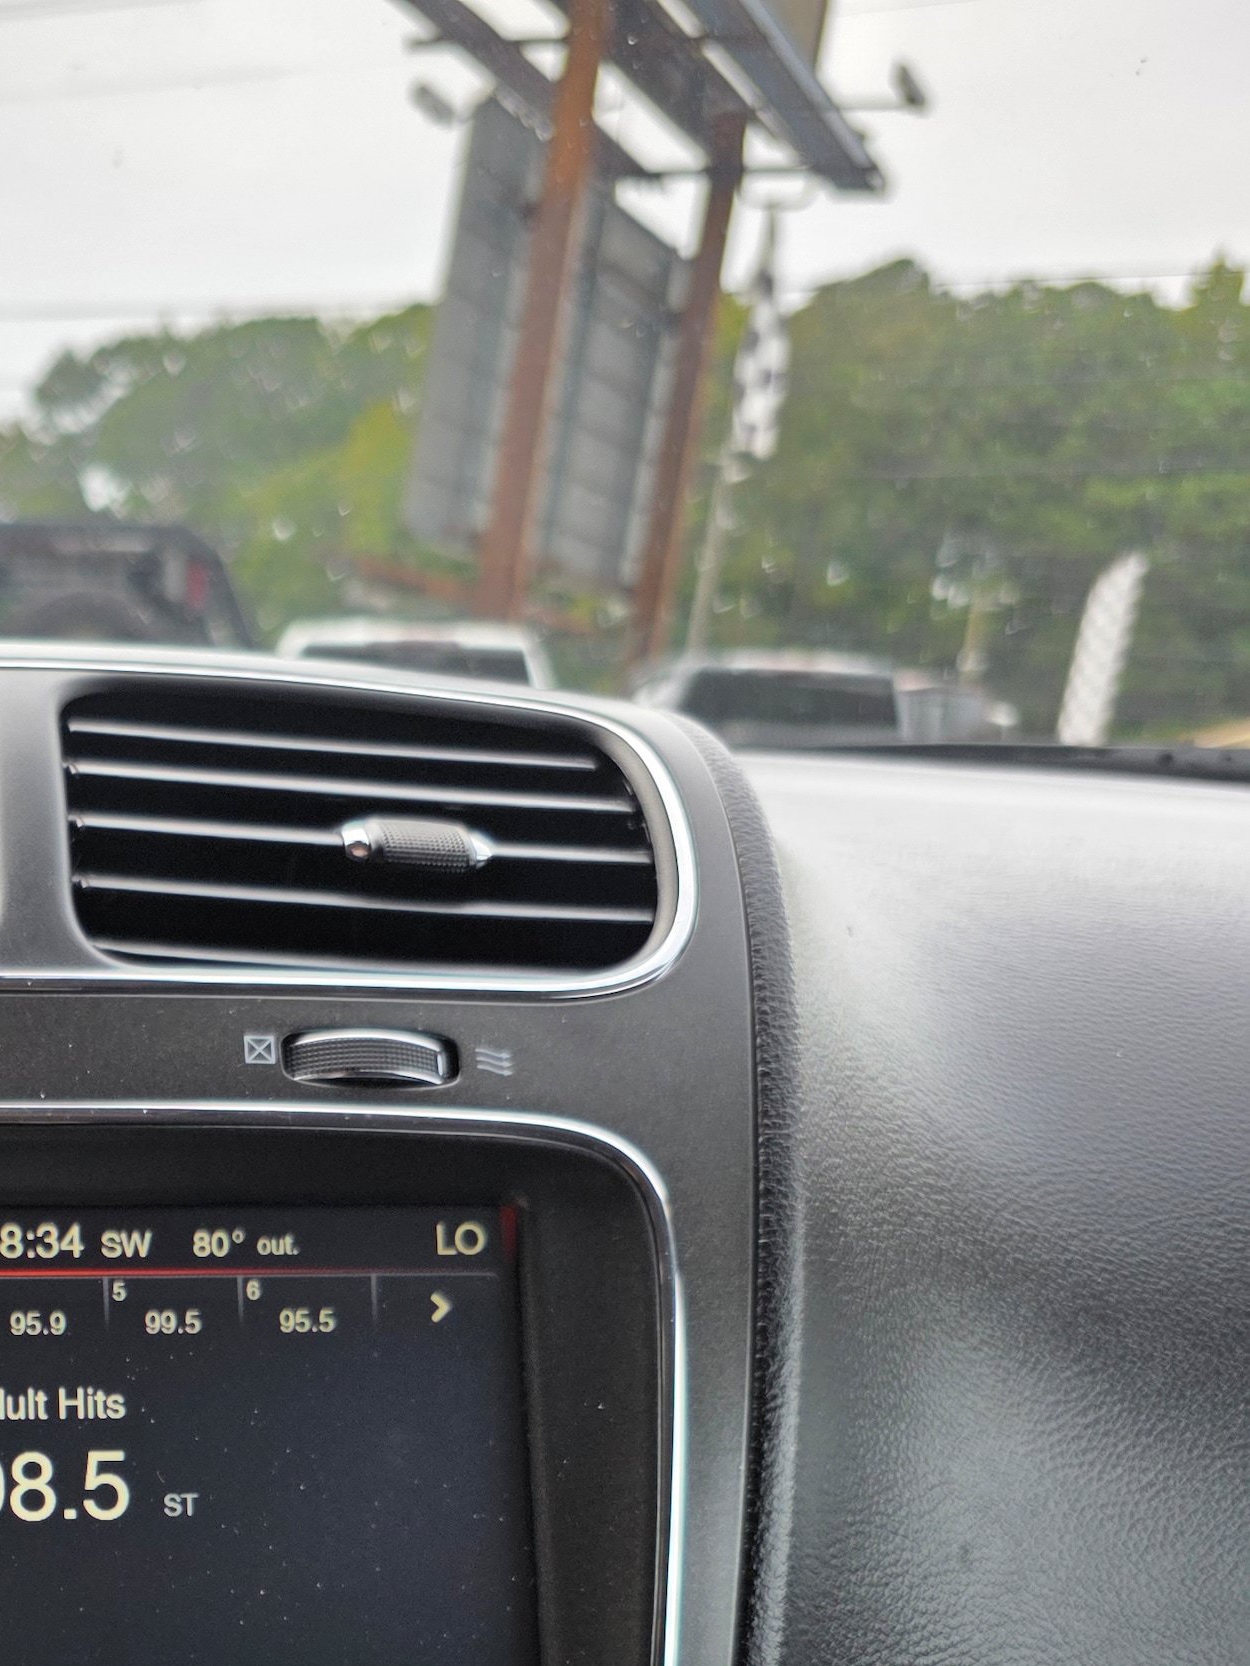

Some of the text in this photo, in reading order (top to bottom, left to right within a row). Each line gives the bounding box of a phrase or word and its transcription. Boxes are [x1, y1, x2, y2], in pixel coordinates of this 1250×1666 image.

[0, 1223, 152, 1258] 8:34 SW
[257, 1234, 298, 1255] out.
[437, 1222, 486, 1255] LO
[112, 1281, 126, 1301] 5
[246, 1280, 260, 1300] 6
[10, 1311, 66, 1335] 95.9
[145, 1310, 201, 1334] 99.5
[280, 1309, 335, 1333] 95.5
[59, 1387, 125, 1419] Hits
[164, 1493, 198, 1516] ST
